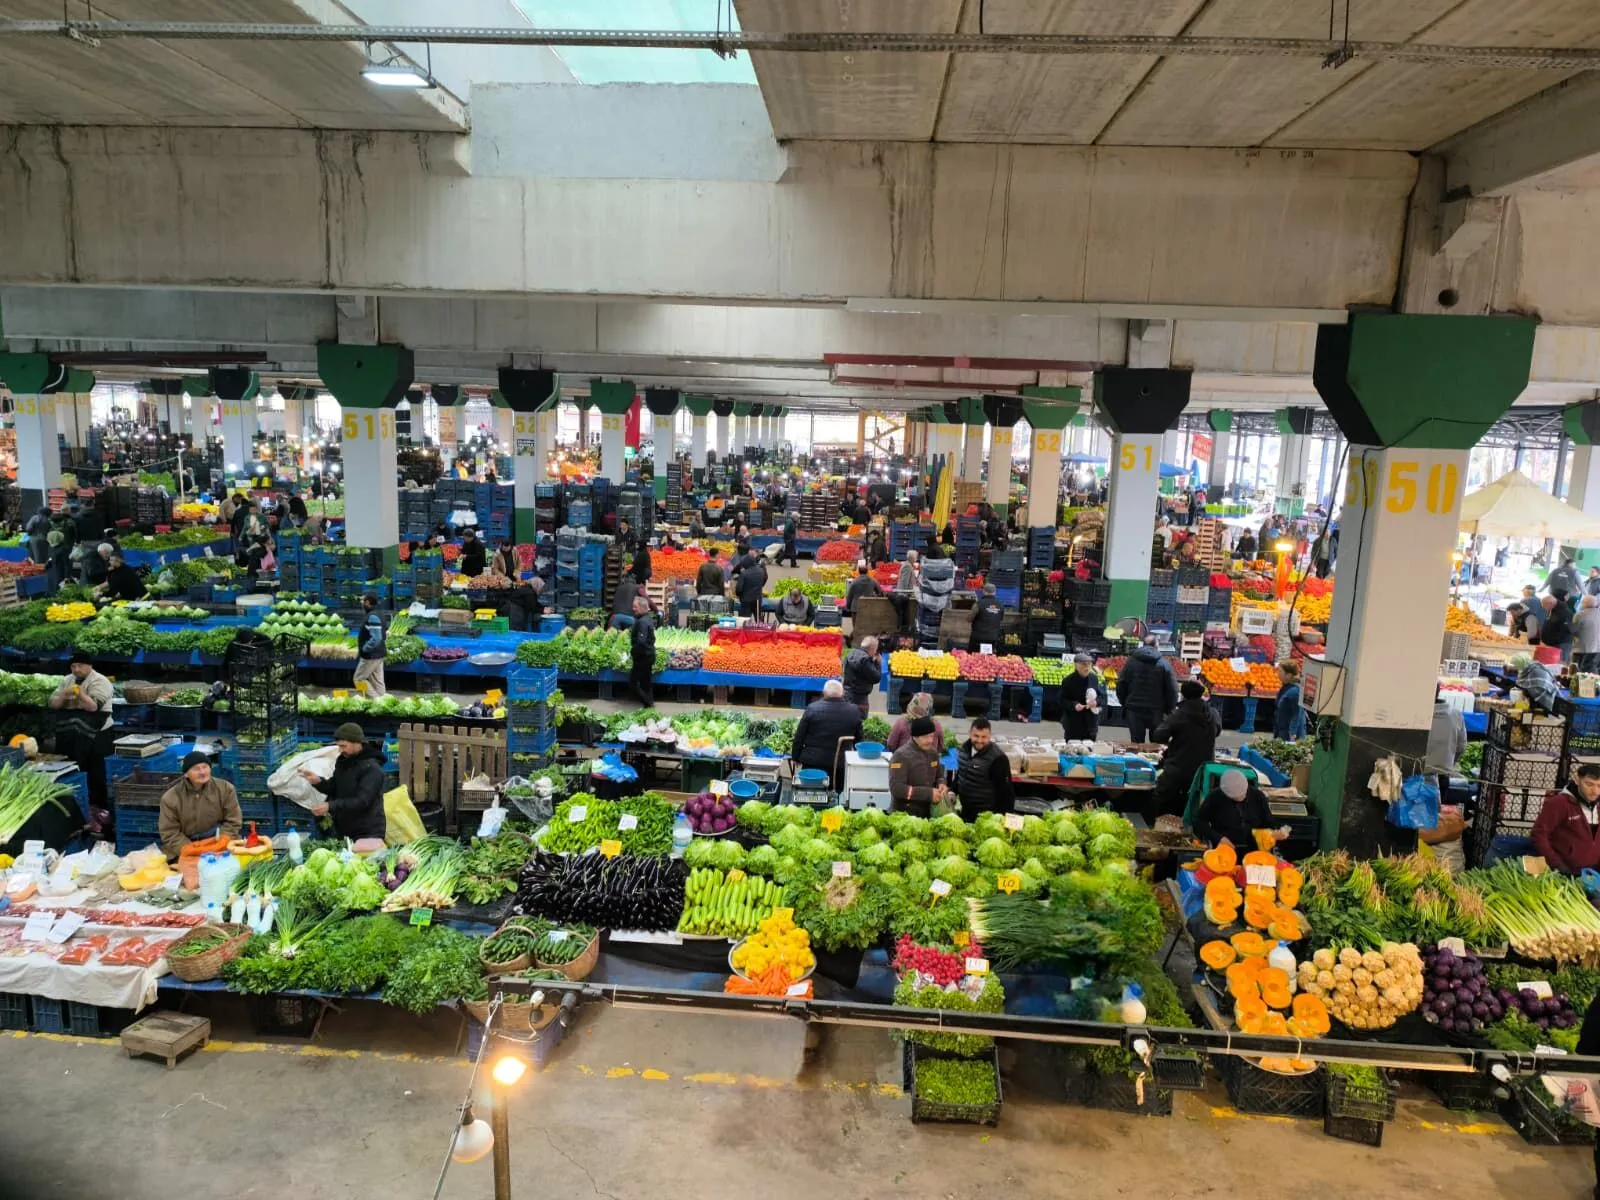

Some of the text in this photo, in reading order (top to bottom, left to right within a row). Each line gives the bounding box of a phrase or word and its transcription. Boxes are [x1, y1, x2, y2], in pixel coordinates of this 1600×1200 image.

[343, 412, 375, 440] 51
[515, 415, 535, 433] 52
[603, 416, 621, 431] 53
[994, 430, 1012, 446] 53
[1036, 432, 1060, 453] 52
[1120, 443, 1153, 472] 51
[1384, 461, 1458, 514] 50
